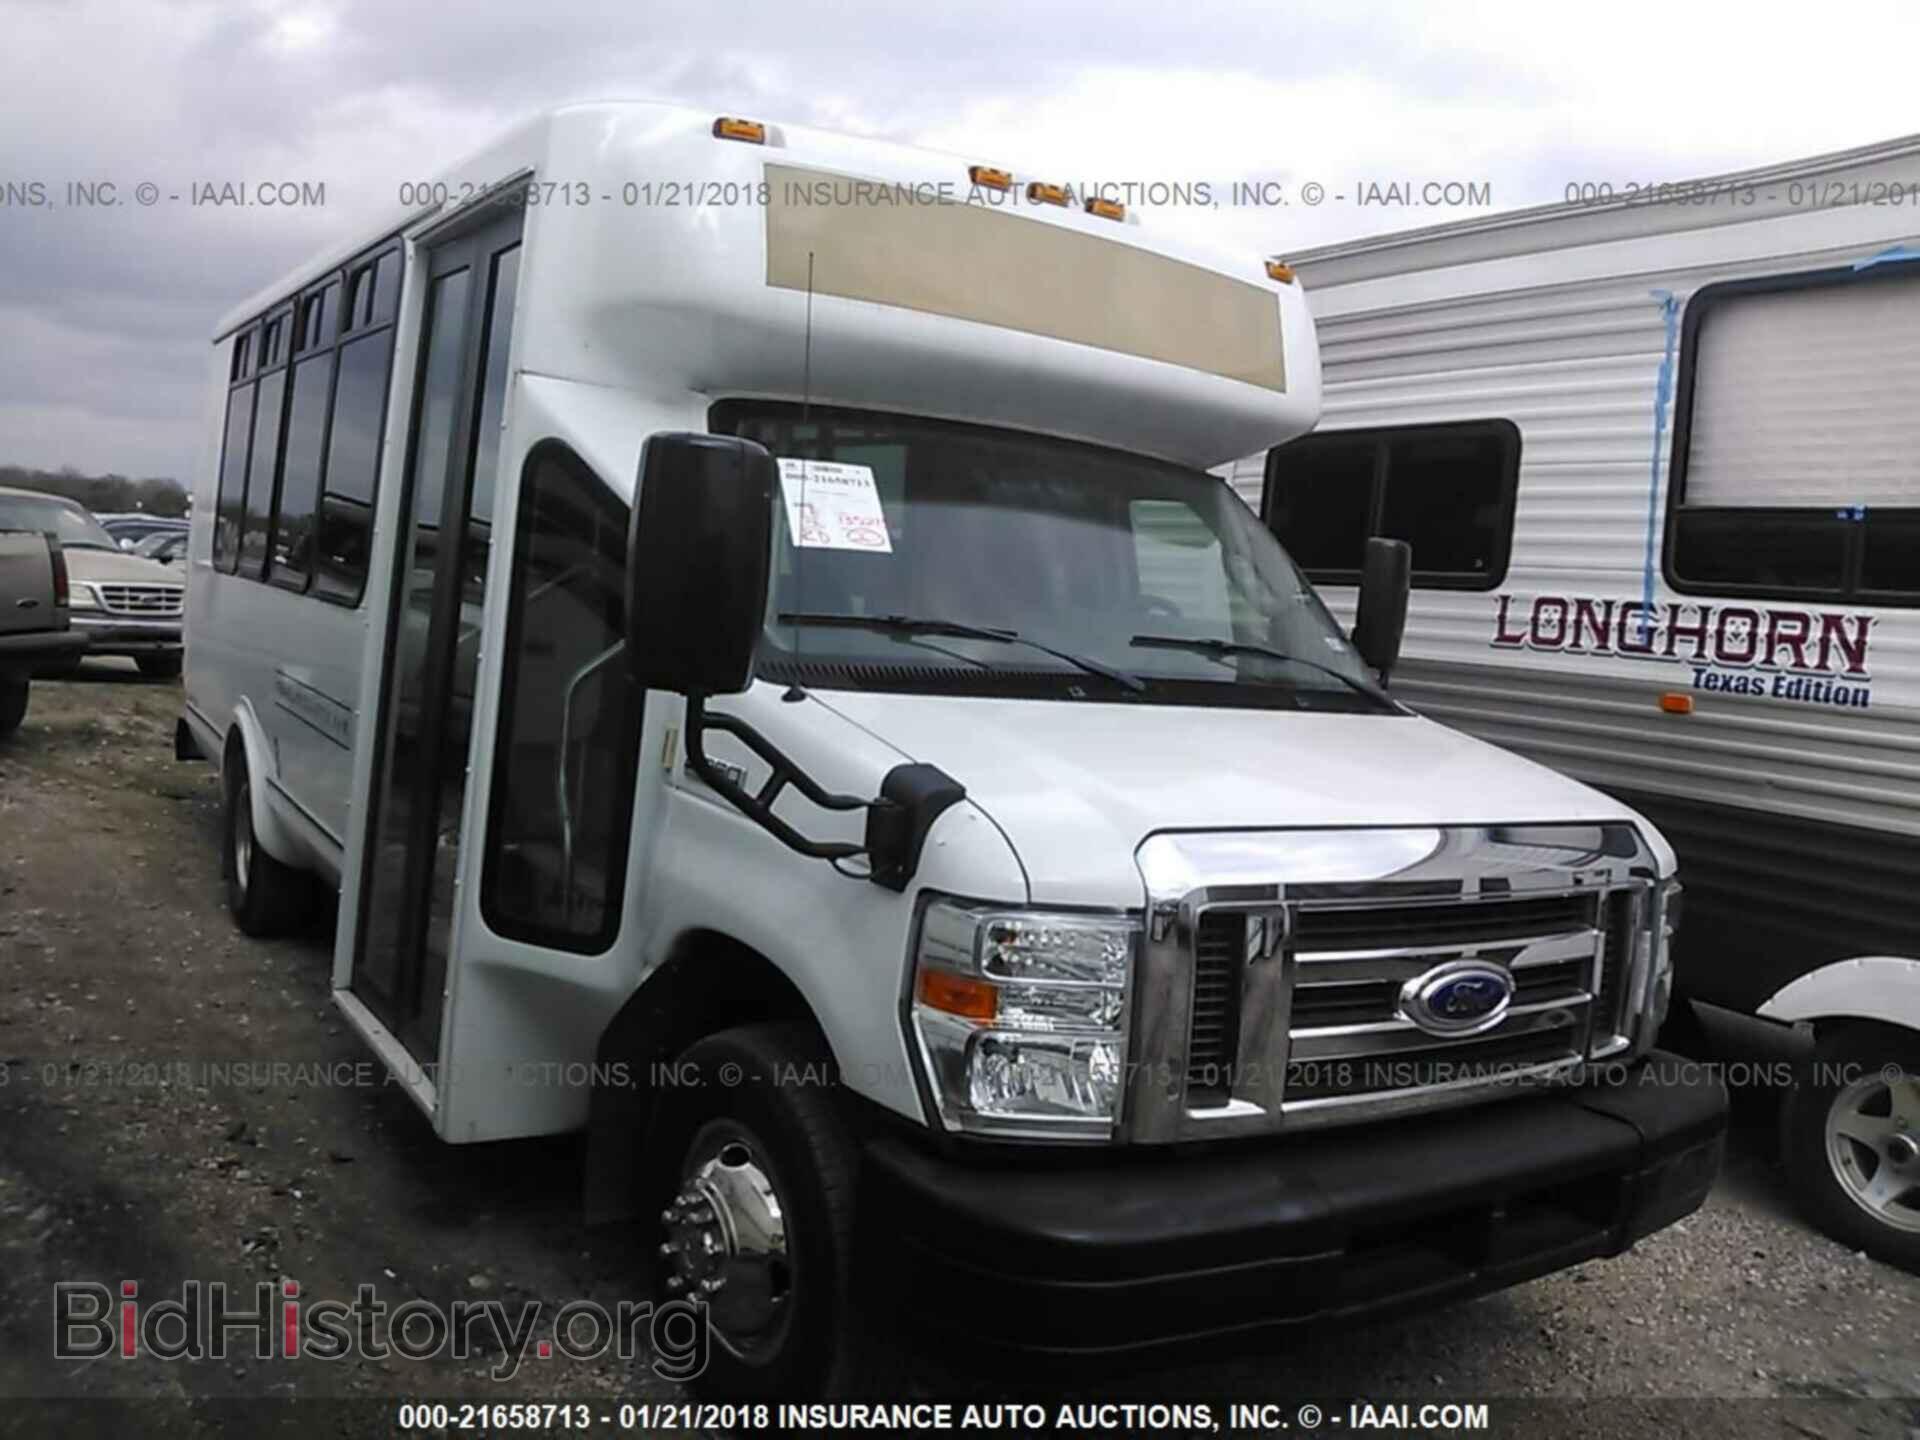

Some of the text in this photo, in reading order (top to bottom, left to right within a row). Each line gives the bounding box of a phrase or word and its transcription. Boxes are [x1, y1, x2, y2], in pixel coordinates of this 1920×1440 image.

[1490, 595, 1878, 681] LONGHORN
[1691, 667, 1871, 709] Texas Edition
